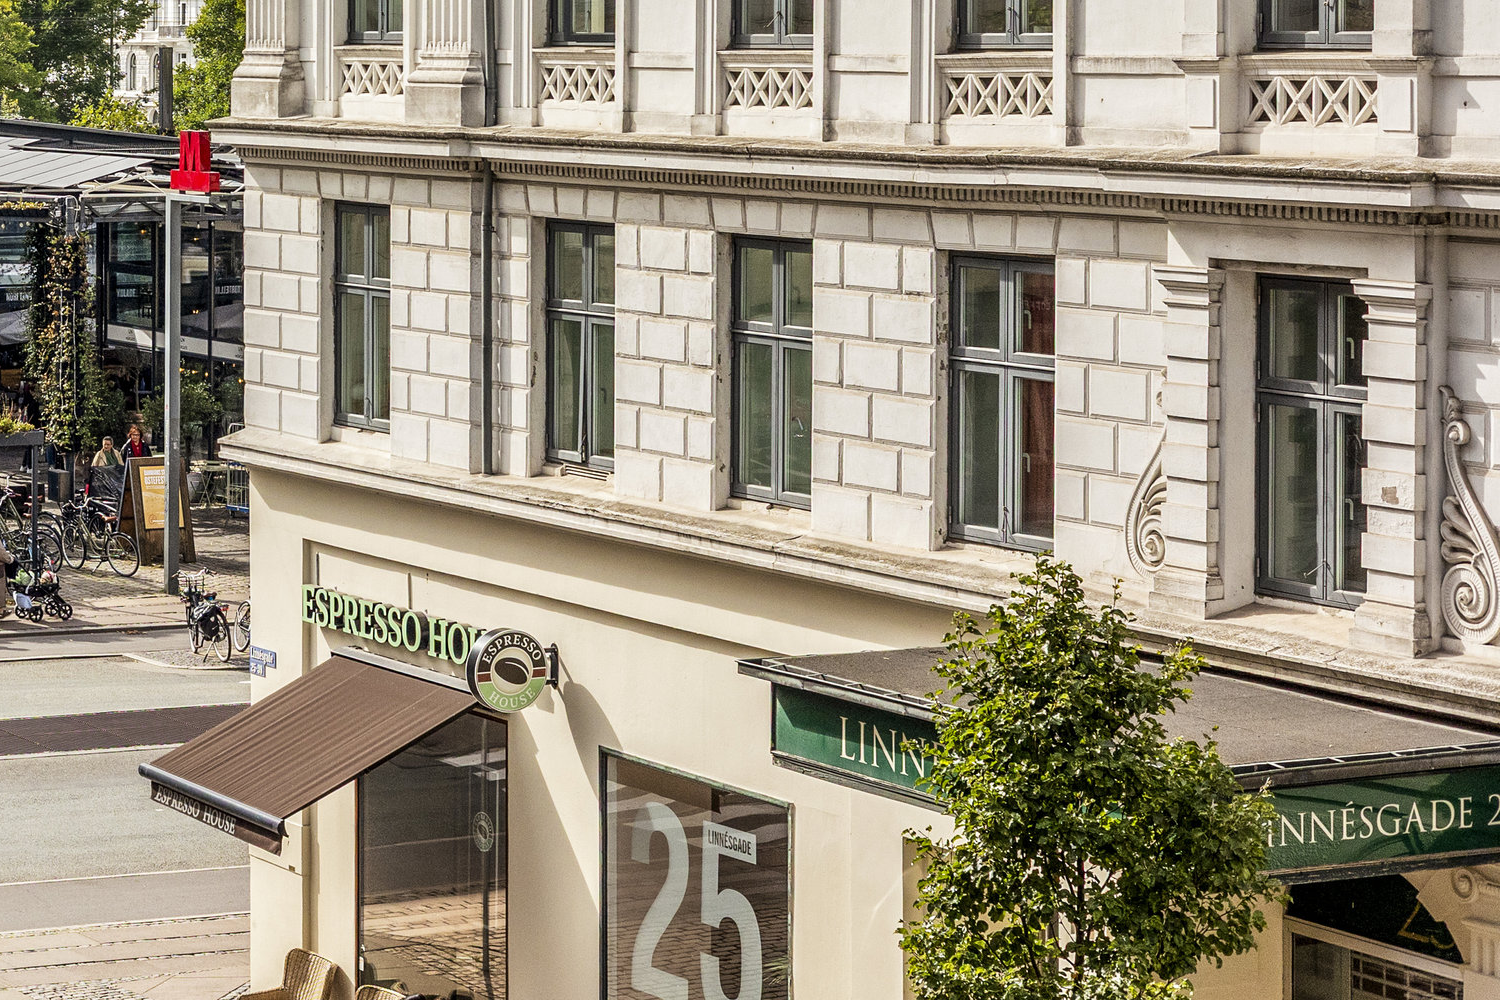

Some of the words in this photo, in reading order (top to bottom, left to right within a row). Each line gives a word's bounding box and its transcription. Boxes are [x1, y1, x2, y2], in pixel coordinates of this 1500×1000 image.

[301, 584, 423, 653] ESPRESSO
[482, 633, 542, 665] ESPRESSO
[488, 686, 537, 709] HOUSE
[153, 784, 201, 818] ESPRESSO
[202, 804, 237, 835] HOUSE
[1267, 796, 1474, 848] INNÉSGADE
[707, 829, 752, 856] LINNÉSGADE
[631, 801, 763, 1000] 25
